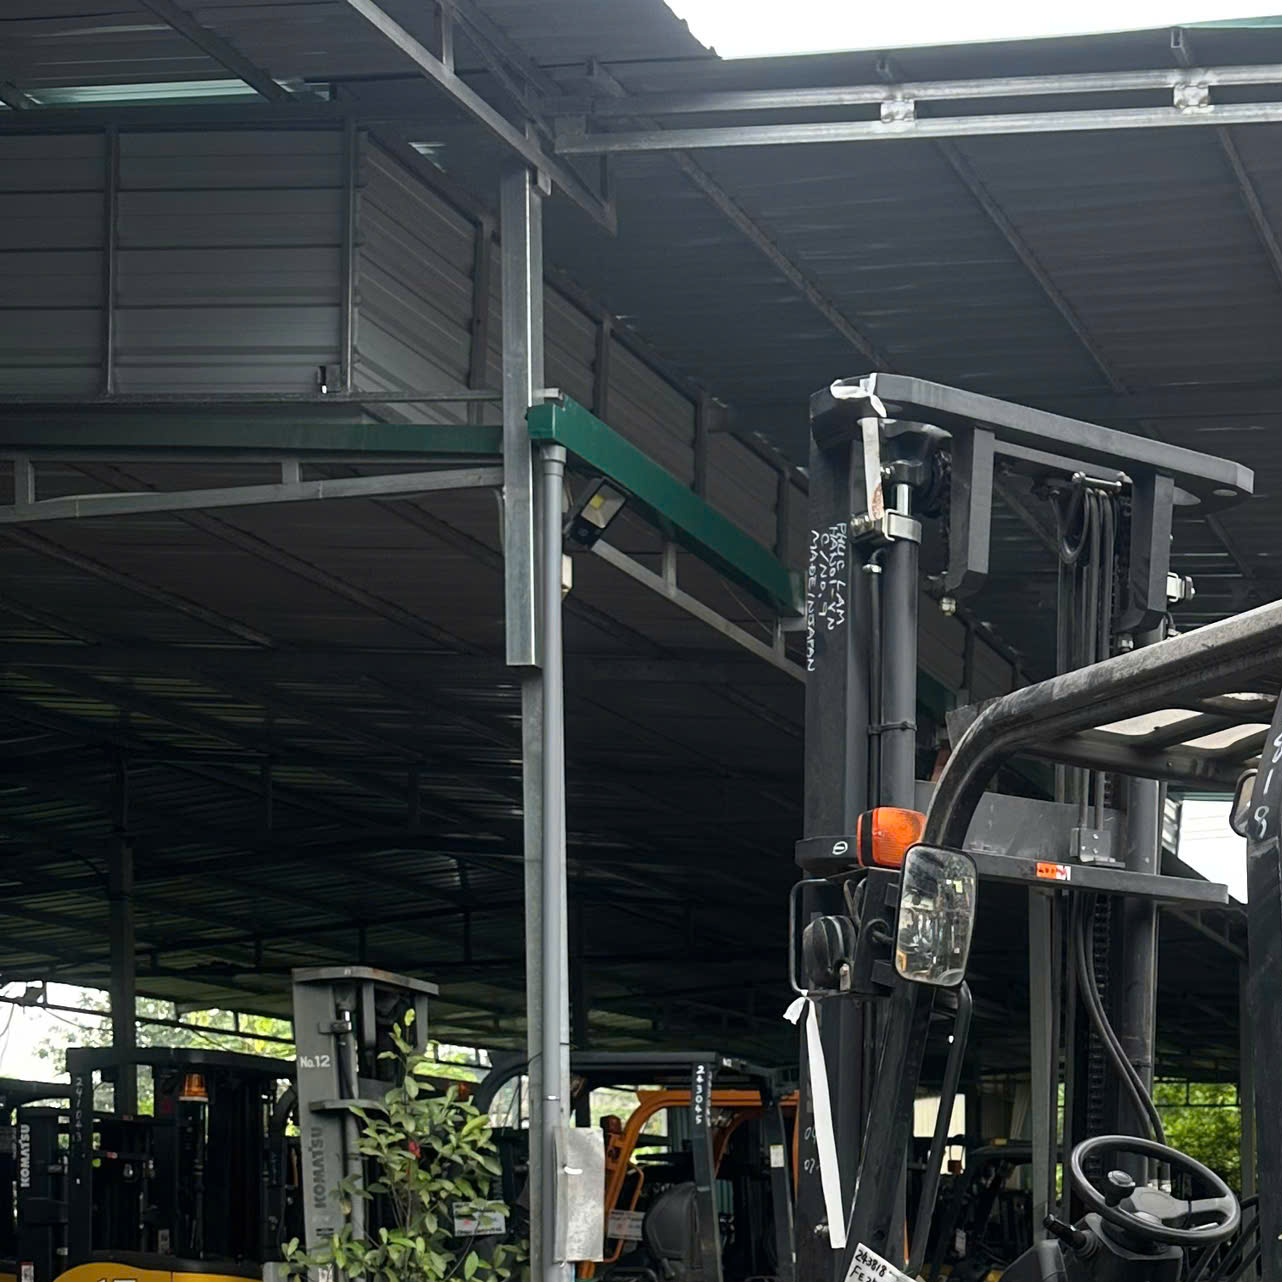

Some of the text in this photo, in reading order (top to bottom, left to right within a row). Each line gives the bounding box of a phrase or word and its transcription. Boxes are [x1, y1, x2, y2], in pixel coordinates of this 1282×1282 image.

[835, 522, 848, 625] PHUC LAM
[20, 1124, 31, 1188] KOMATSU
[308, 1127, 327, 1209] KOMATSU
[855, 1249, 887, 1278] 243818
